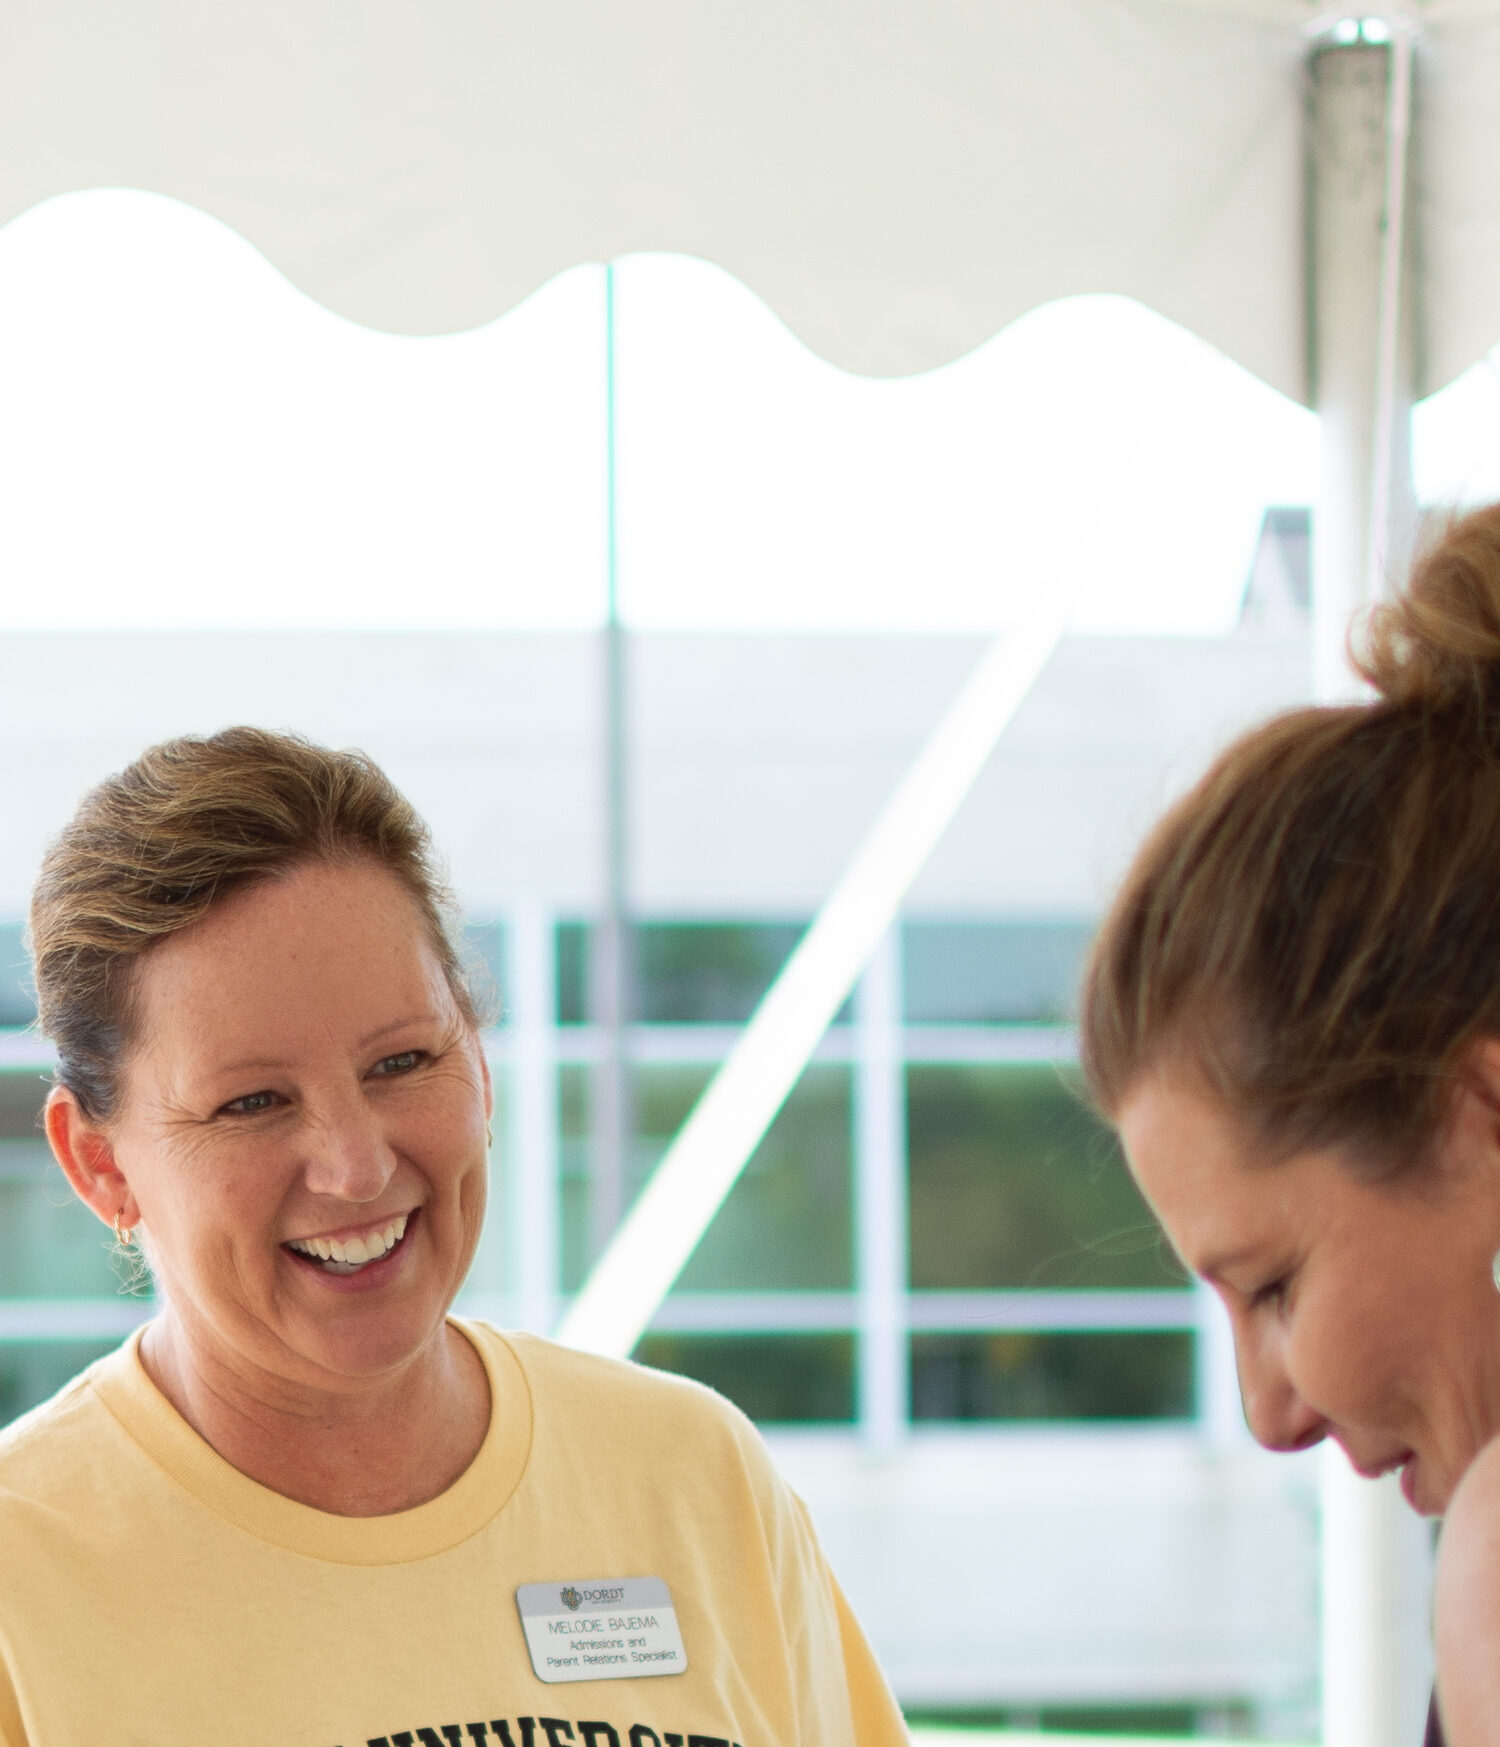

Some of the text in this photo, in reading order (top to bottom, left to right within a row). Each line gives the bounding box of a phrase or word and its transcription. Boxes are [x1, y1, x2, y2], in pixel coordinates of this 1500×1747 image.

[584, 1588, 624, 1600] DORDT
[548, 1615, 660, 1635] MELODIE BAJEMA
[570, 1637, 646, 1650] Admissions and
[547, 1650, 678, 1668] Parent Relations Specialist
